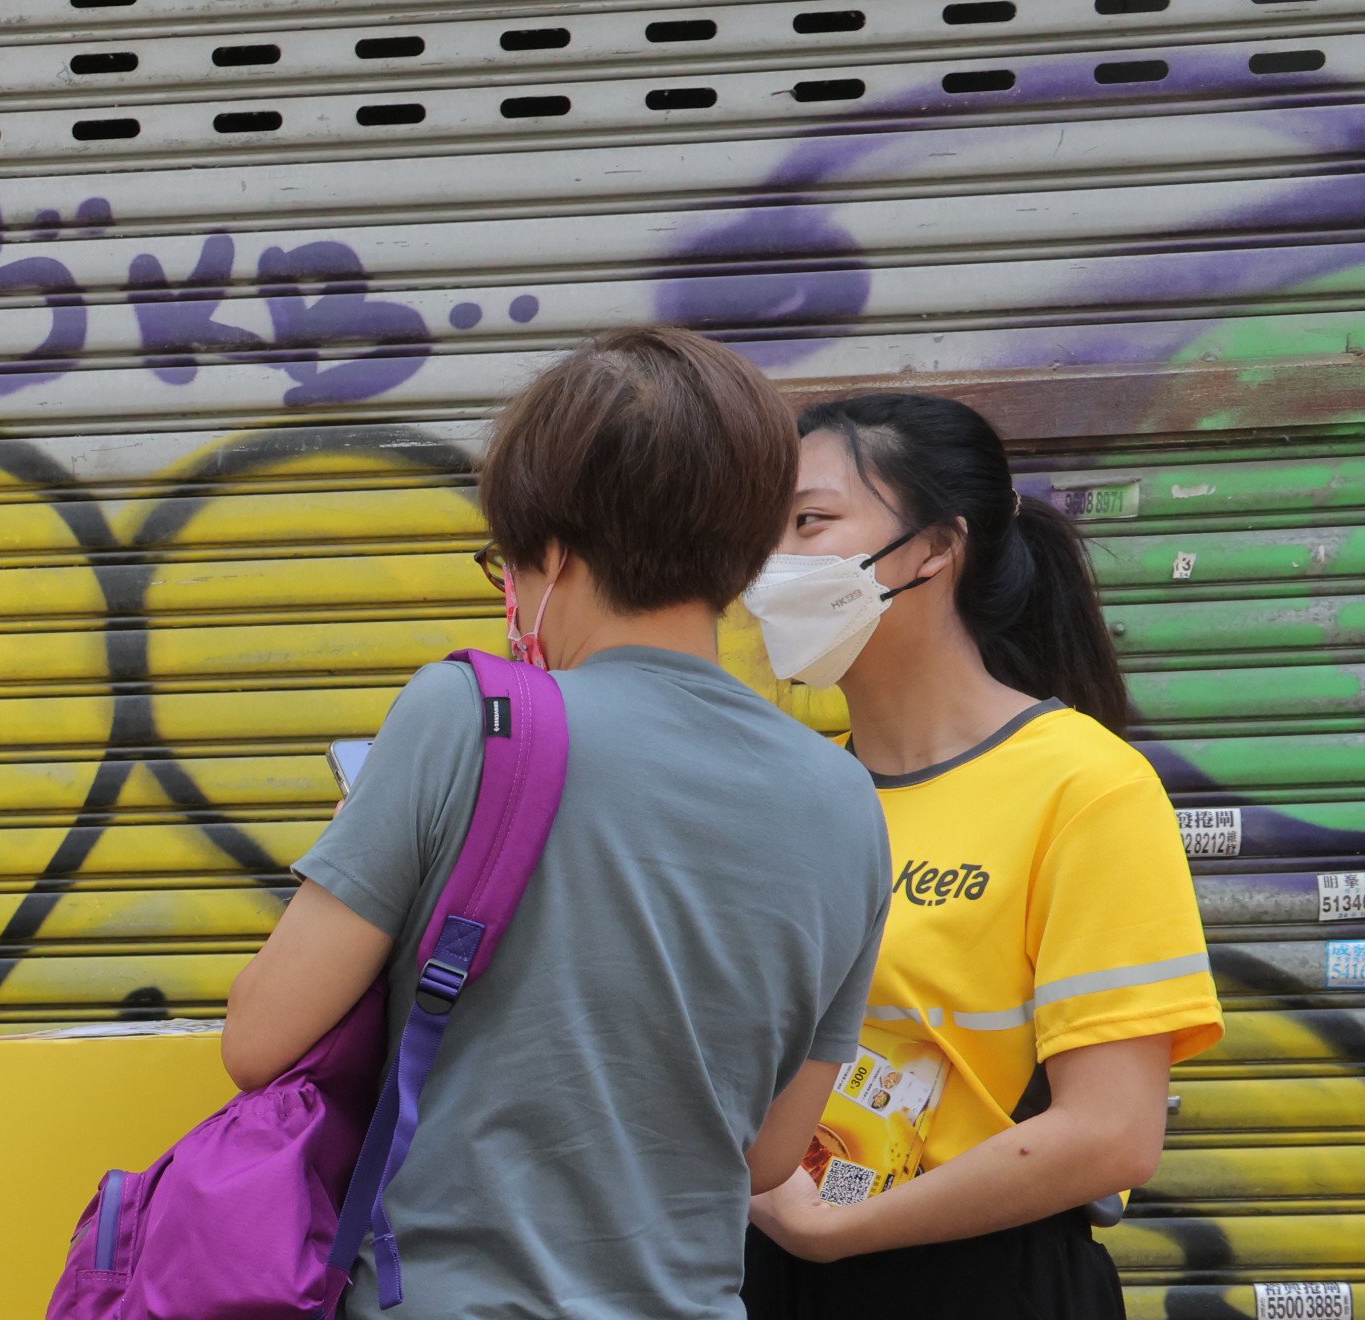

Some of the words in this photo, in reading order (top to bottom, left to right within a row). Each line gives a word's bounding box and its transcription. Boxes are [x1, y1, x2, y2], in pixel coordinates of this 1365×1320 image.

[893, 860, 990, 906] KeeTa
[1323, 894, 1365, 913] 5134
[1268, 1296, 1304, 1320] 5500
[1306, 1295, 1343, 1318] 3885
